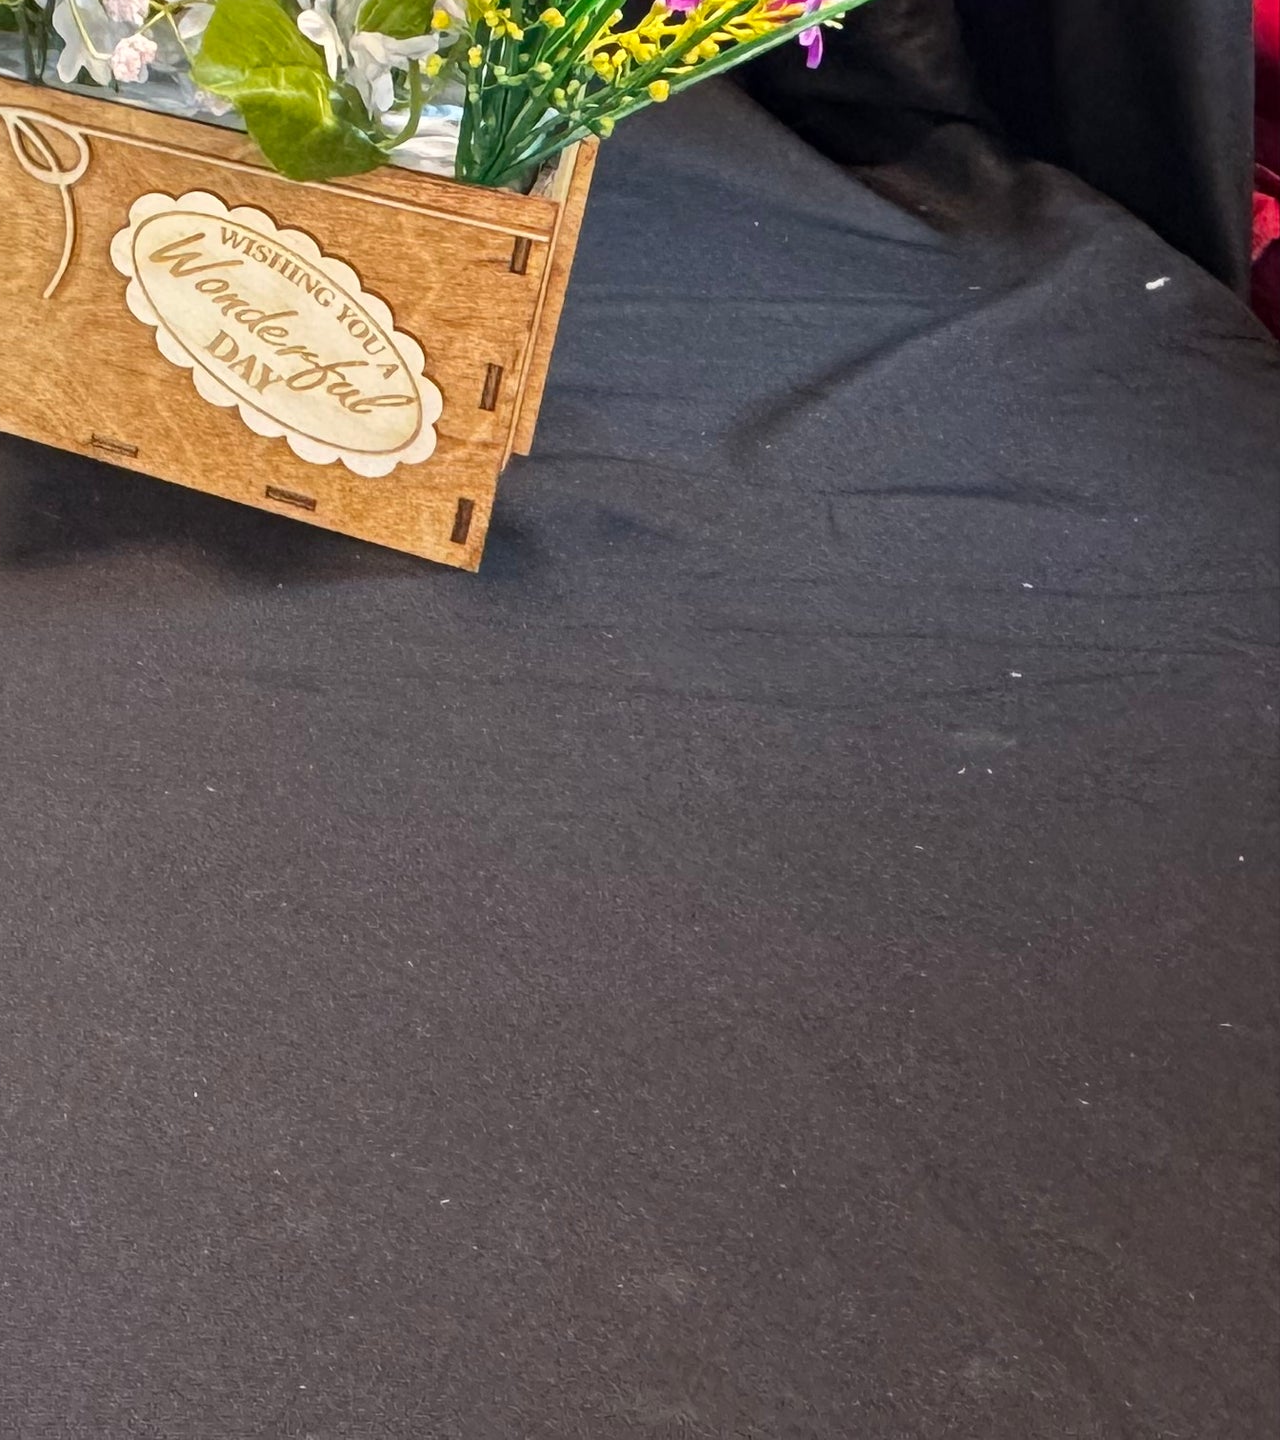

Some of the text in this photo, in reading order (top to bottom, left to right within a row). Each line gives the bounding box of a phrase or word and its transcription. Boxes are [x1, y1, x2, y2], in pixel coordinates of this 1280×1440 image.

[148, 232, 418, 414] Wonderful
[204, 329, 285, 395] DAY
[219, 226, 400, 381] WISHING YOU A
